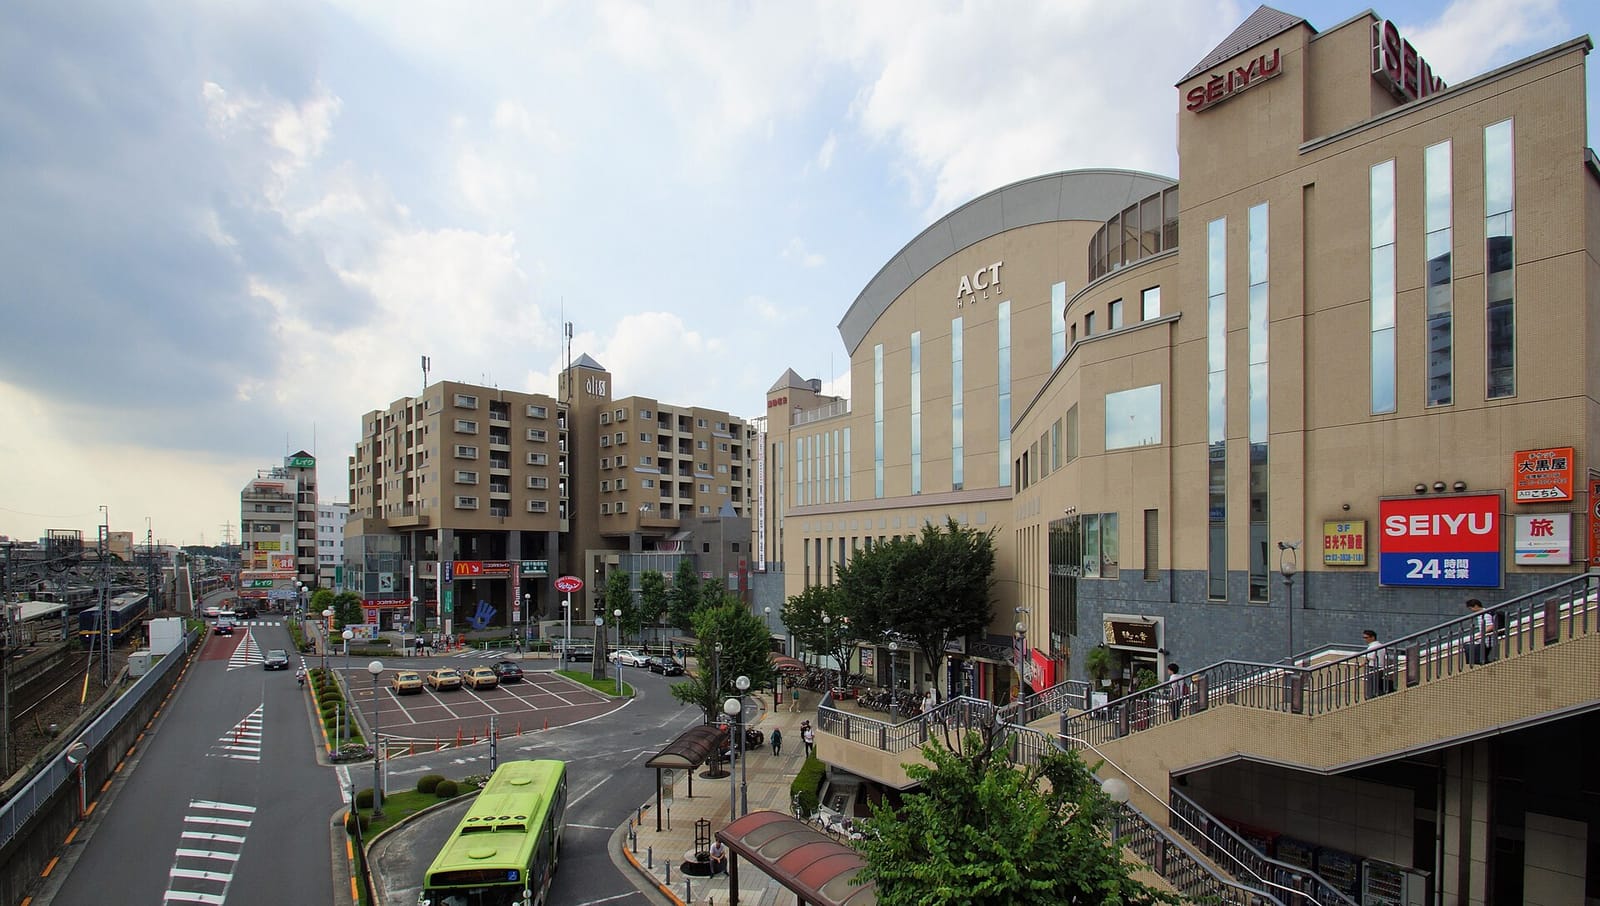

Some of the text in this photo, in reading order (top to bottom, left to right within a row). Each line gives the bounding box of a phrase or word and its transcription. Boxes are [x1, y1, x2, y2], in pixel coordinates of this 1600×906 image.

[1186, 48, 1280, 111] SEIYU
[957, 261, 1004, 298] ACT
[957, 286, 1003, 309] HALL
[1519, 457, 1567, 473] 大黒屋
[1531, 489, 1558, 498] こちら
[1337, 524, 1351, 532] 3F
[1385, 512, 1493, 536] SEIYU
[1529, 518, 1554, 537] 旅
[1325, 534, 1363, 550] 日光不動産
[1406, 559, 1469, 578] 24 時間
[1444, 569, 1469, 579] 営業
